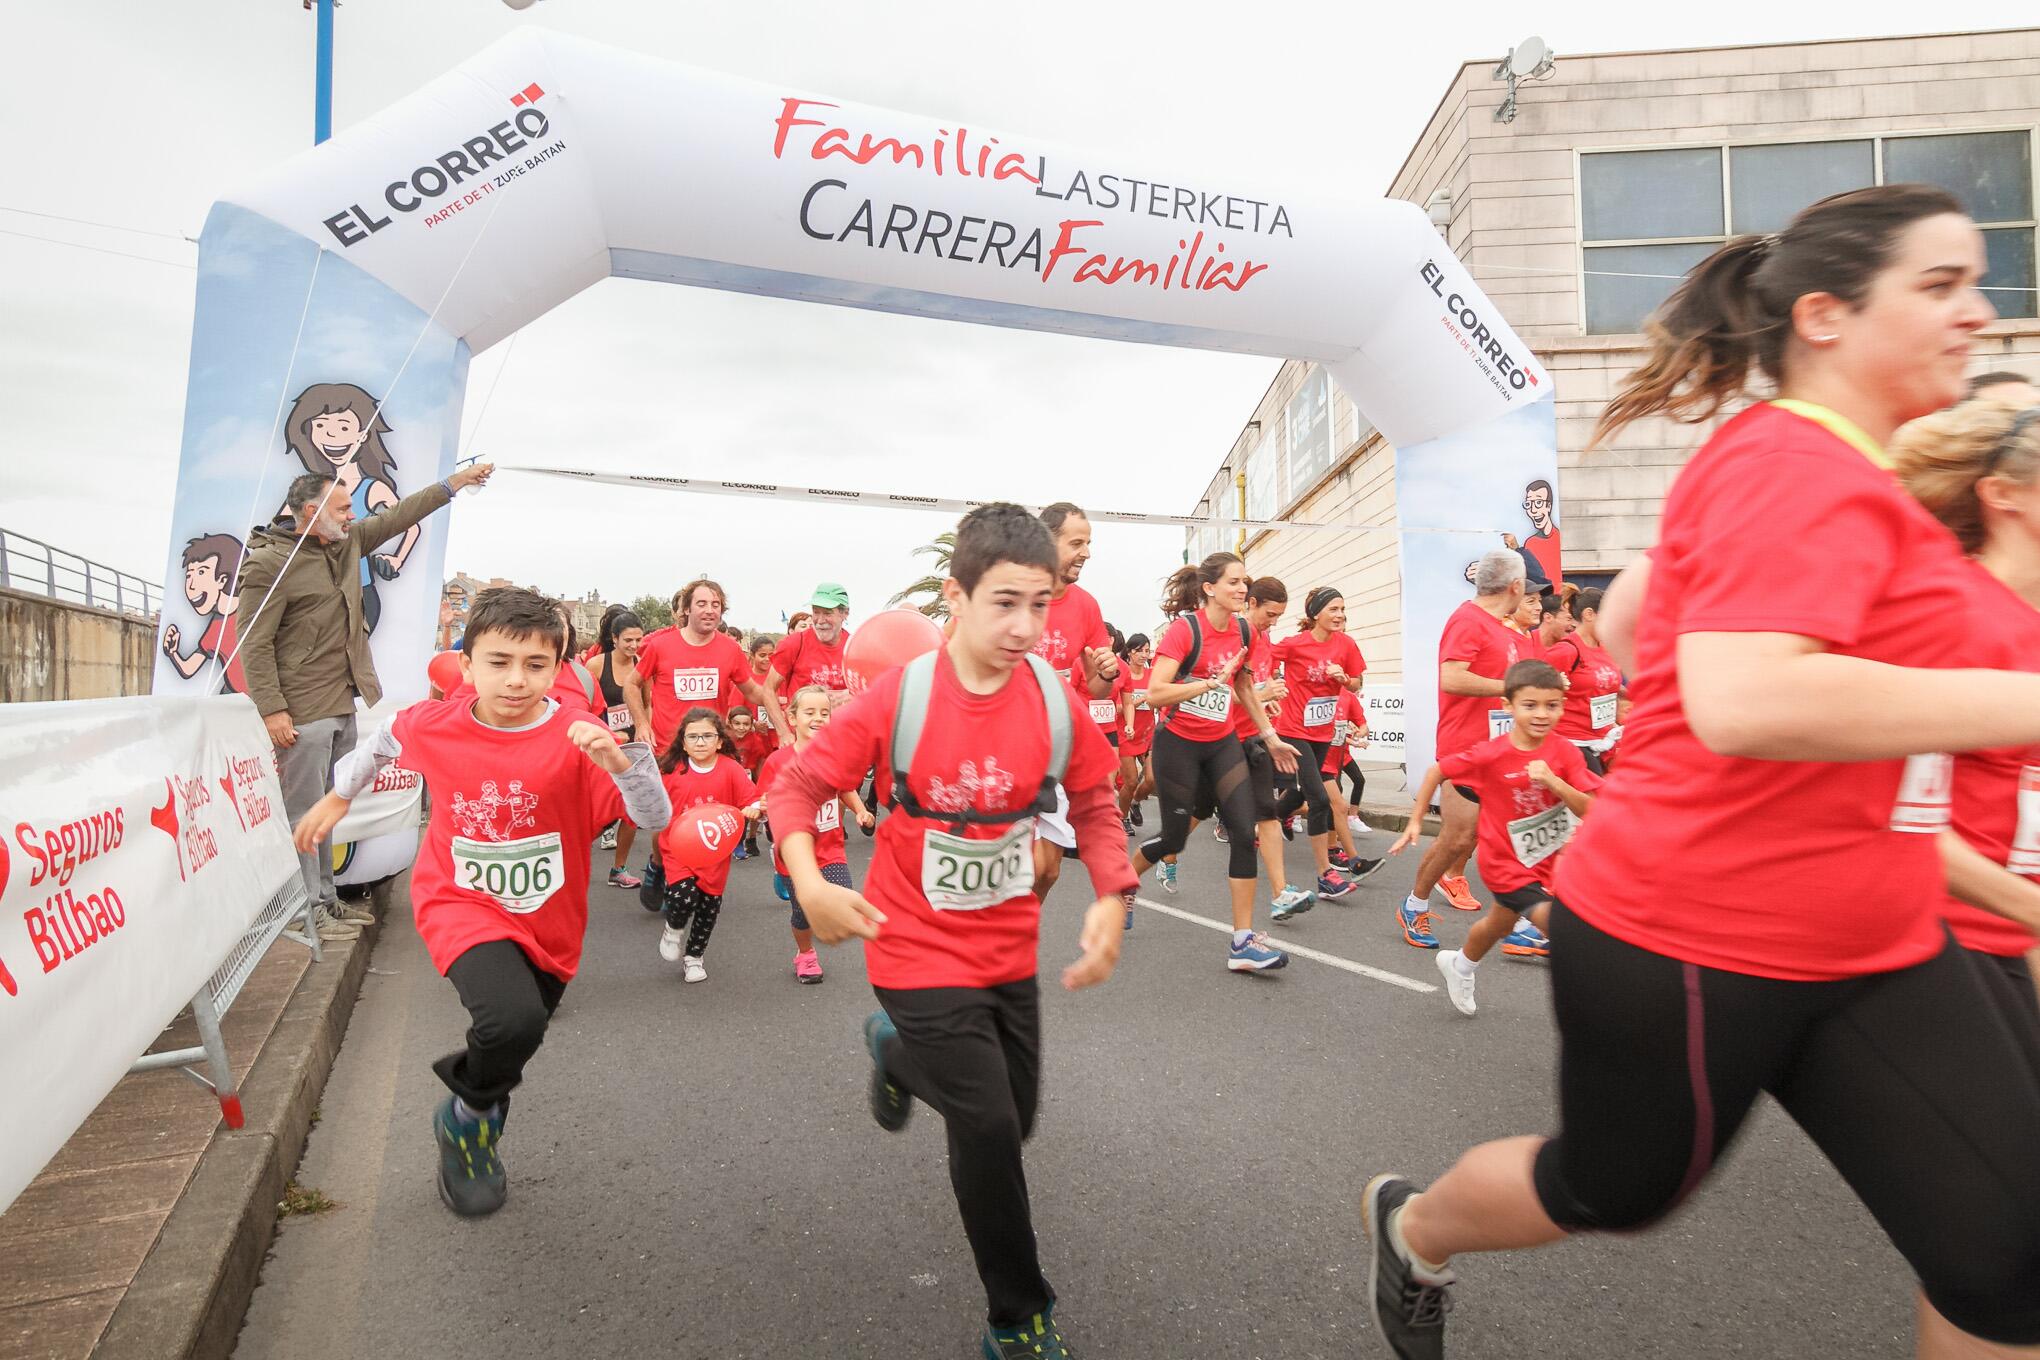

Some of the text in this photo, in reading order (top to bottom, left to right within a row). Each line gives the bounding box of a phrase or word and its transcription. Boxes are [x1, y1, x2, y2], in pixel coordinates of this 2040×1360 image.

[322, 108, 549, 248] EL CORREO
[424, 140, 566, 229] PARTE DE TI ZURE BAITAN
[774, 97, 1294, 238] Familia LASTERKETA
[799, 178, 1268, 291] CARRERA Familiar
[1420, 261, 1526, 390] EL CORREO
[1440, 316, 1513, 402] PARTE DE TI ZURE BAITAN
[680, 677, 714, 693] 3012
[1189, 692, 1227, 712] 038
[1370, 698, 1383, 708] EL
[1093, 706, 1113, 718] 3001
[1309, 703, 1334, 719] 1003
[1367, 731, 1405, 743] EL COR
[232, 755, 266, 790] Seguros
[371, 769, 419, 793] Bilbao
[174, 774, 211, 821] Seguros
[242, 792, 271, 829] Bilbao
[15, 806, 125, 888] Seguros
[185, 823, 219, 874] Bilbao
[465, 856, 552, 897] 2006
[24, 886, 126, 975] Bilbao
